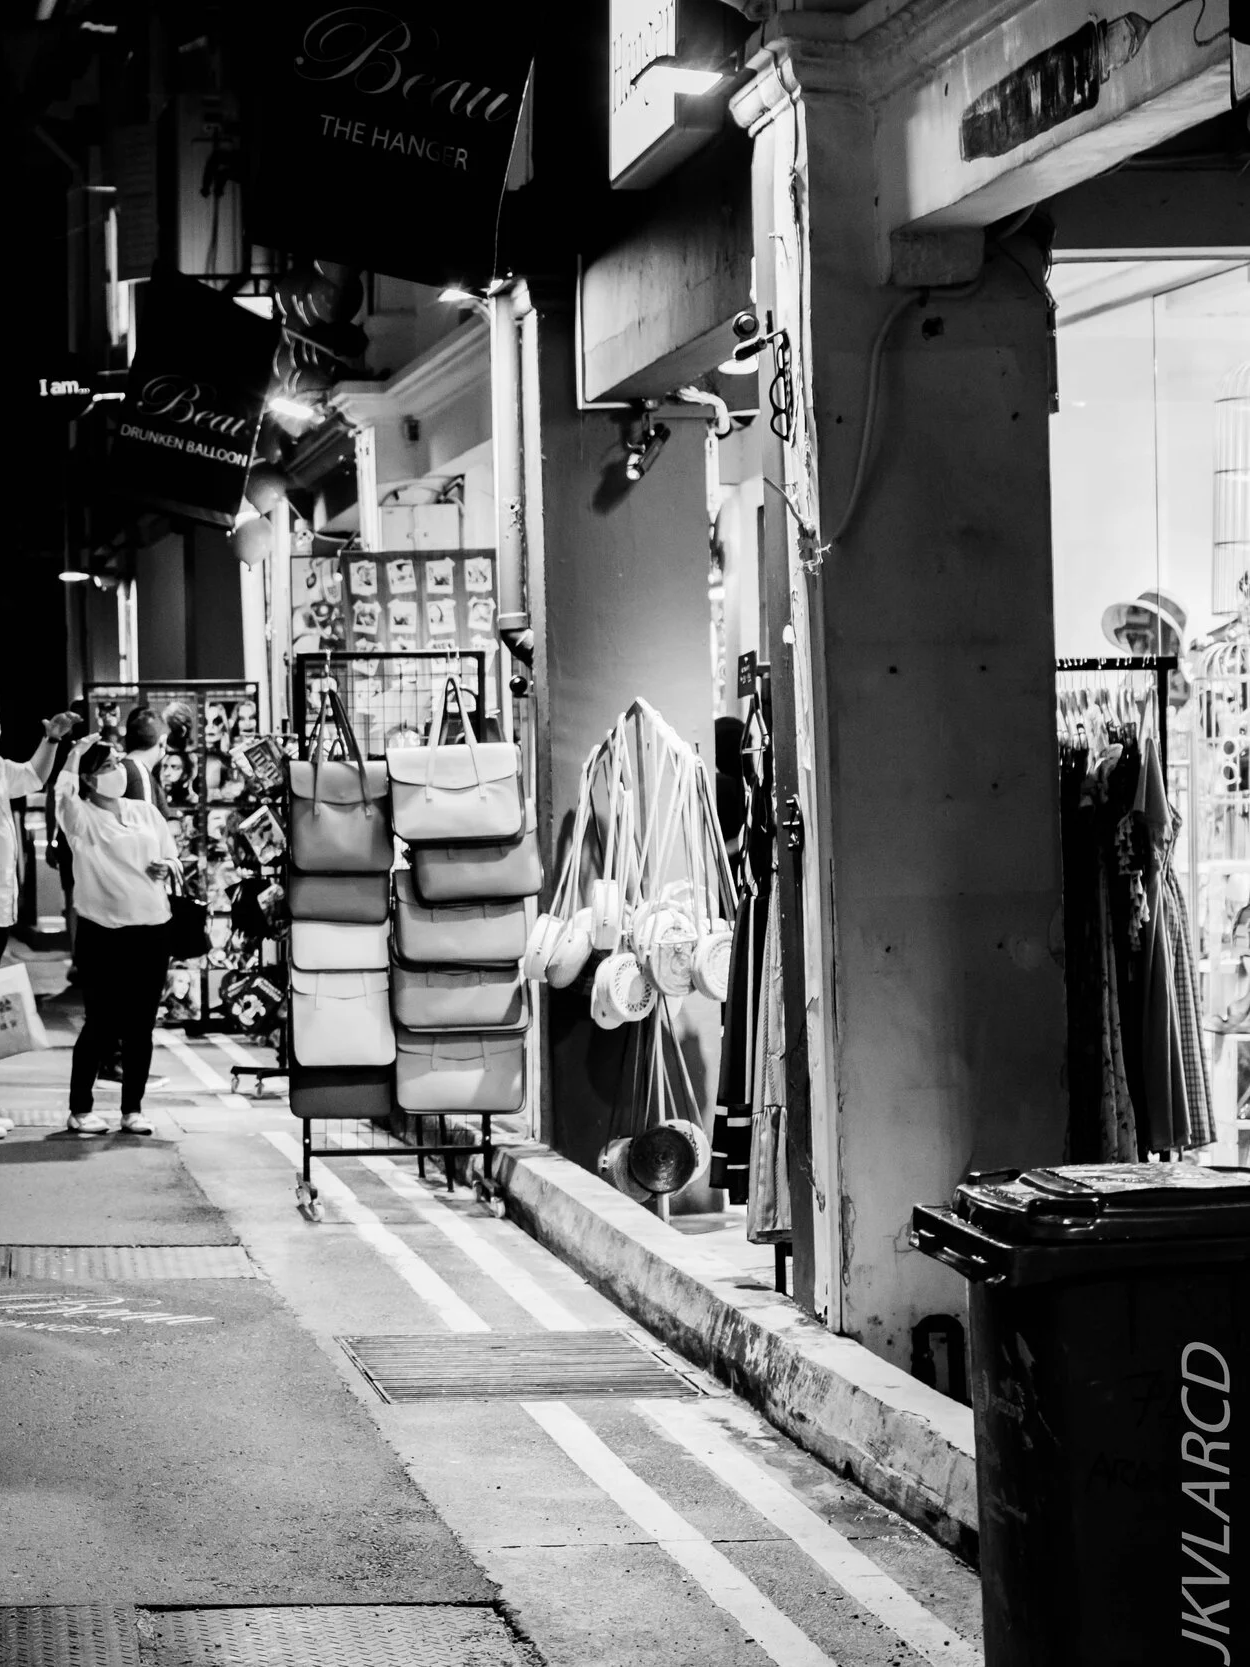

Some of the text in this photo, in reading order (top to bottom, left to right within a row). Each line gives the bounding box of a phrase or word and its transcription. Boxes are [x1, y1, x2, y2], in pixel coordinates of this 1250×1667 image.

[293, 6, 514, 123] Beau
[319, 112, 470, 172] THE HANGER
[120, 423, 248, 468] DRUNKEN BALLOON
